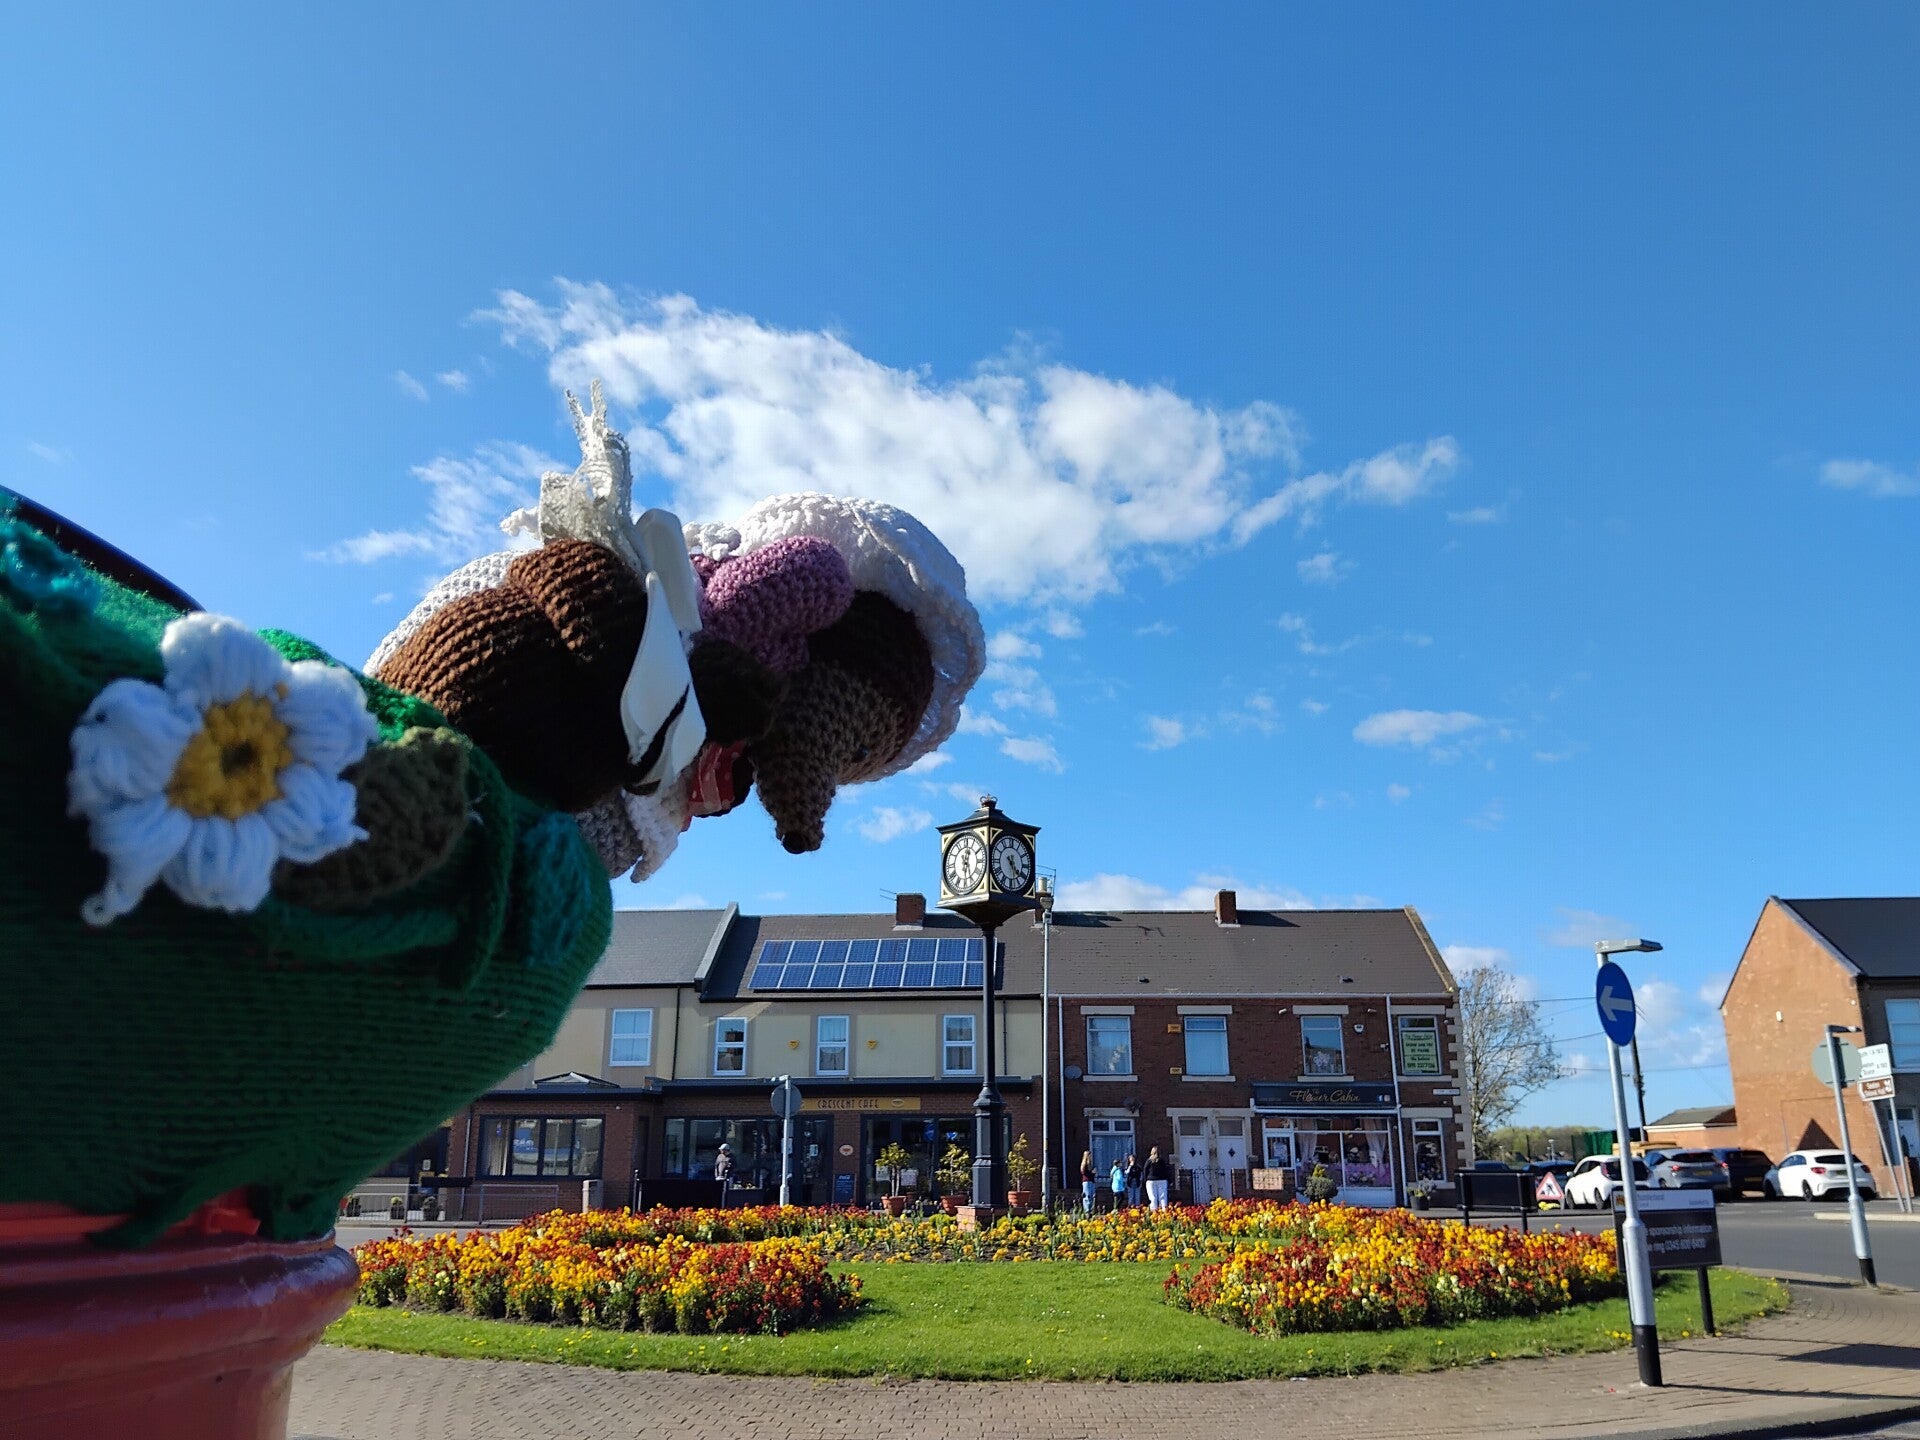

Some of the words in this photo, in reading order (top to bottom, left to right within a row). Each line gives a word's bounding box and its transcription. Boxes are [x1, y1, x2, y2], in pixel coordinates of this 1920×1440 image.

[1330, 1089, 1360, 1103] Cabin
[817, 1098, 855, 1110] CRESCENT
[858, 1098, 880, 1109] CAFE
